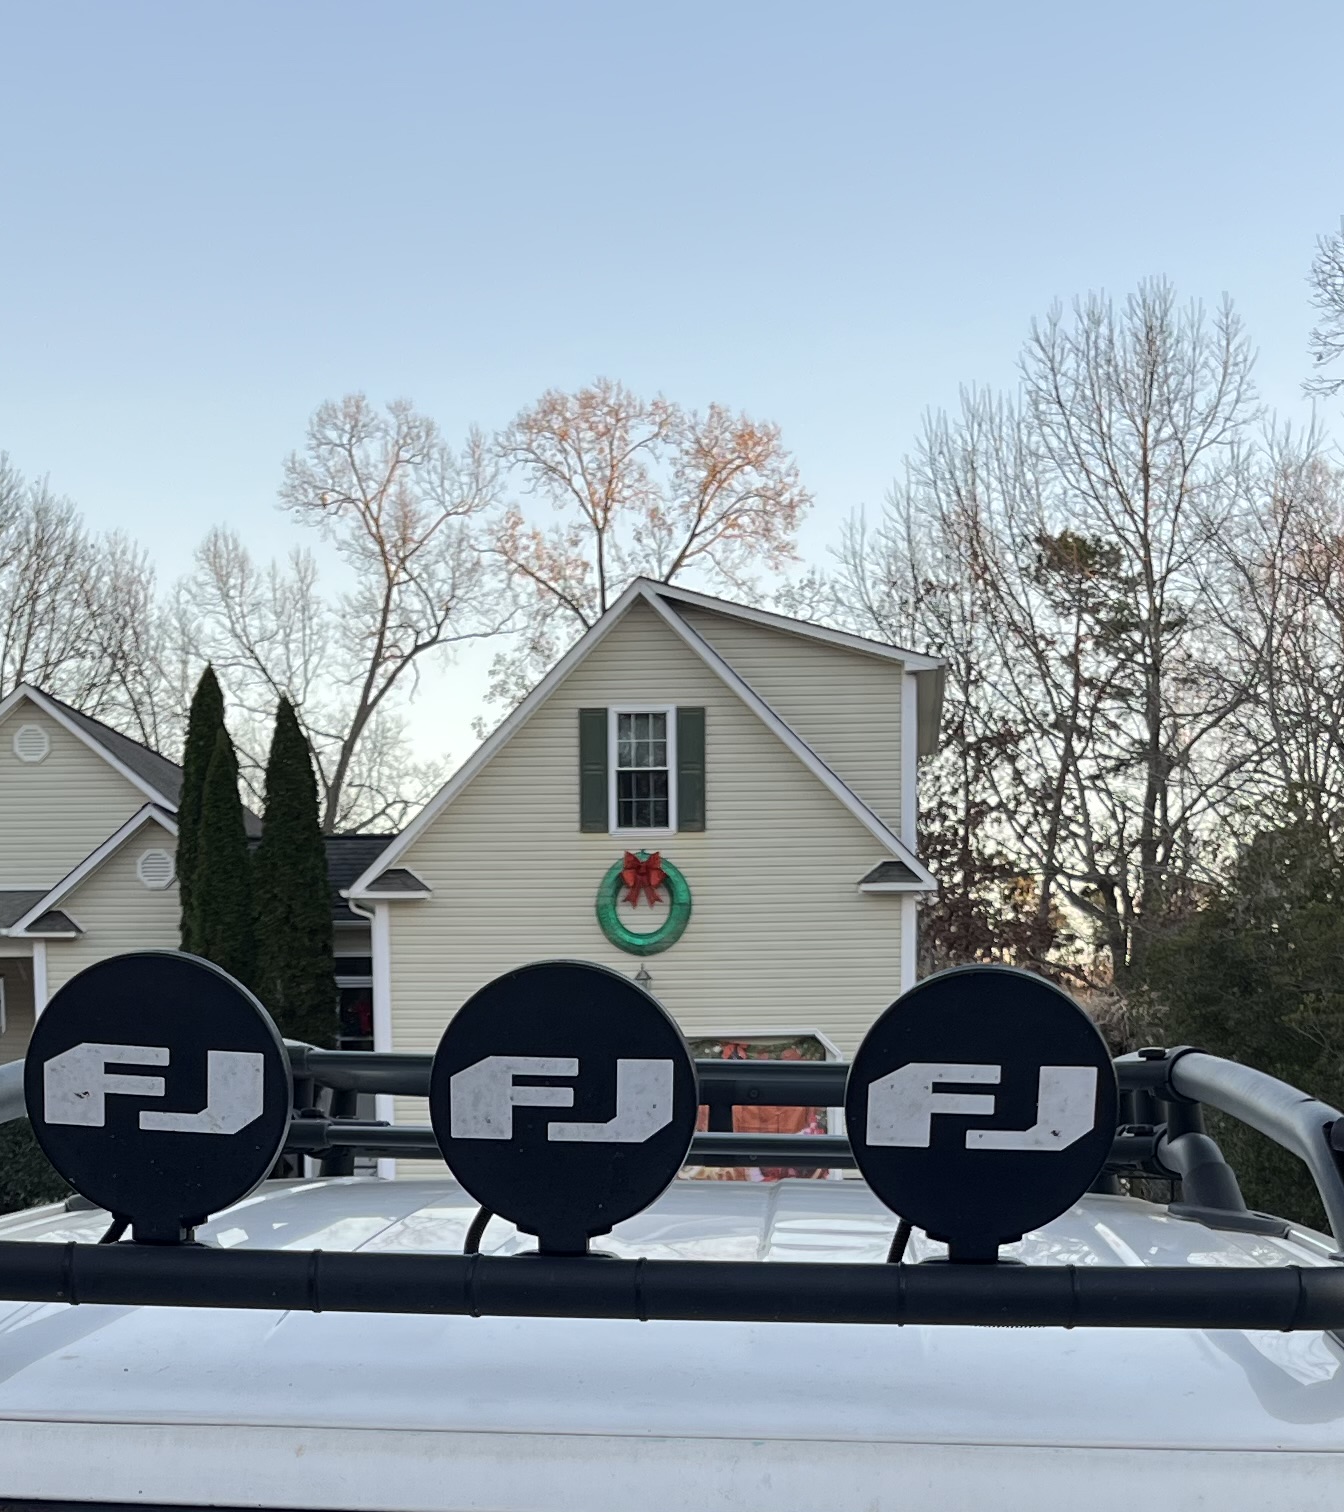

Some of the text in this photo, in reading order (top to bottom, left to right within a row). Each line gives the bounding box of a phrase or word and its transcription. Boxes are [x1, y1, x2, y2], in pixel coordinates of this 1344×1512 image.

[44, 1042, 263, 1134] FJ
[450, 1056, 673, 1142] FJ
[867, 1062, 1098, 1151] FJ
